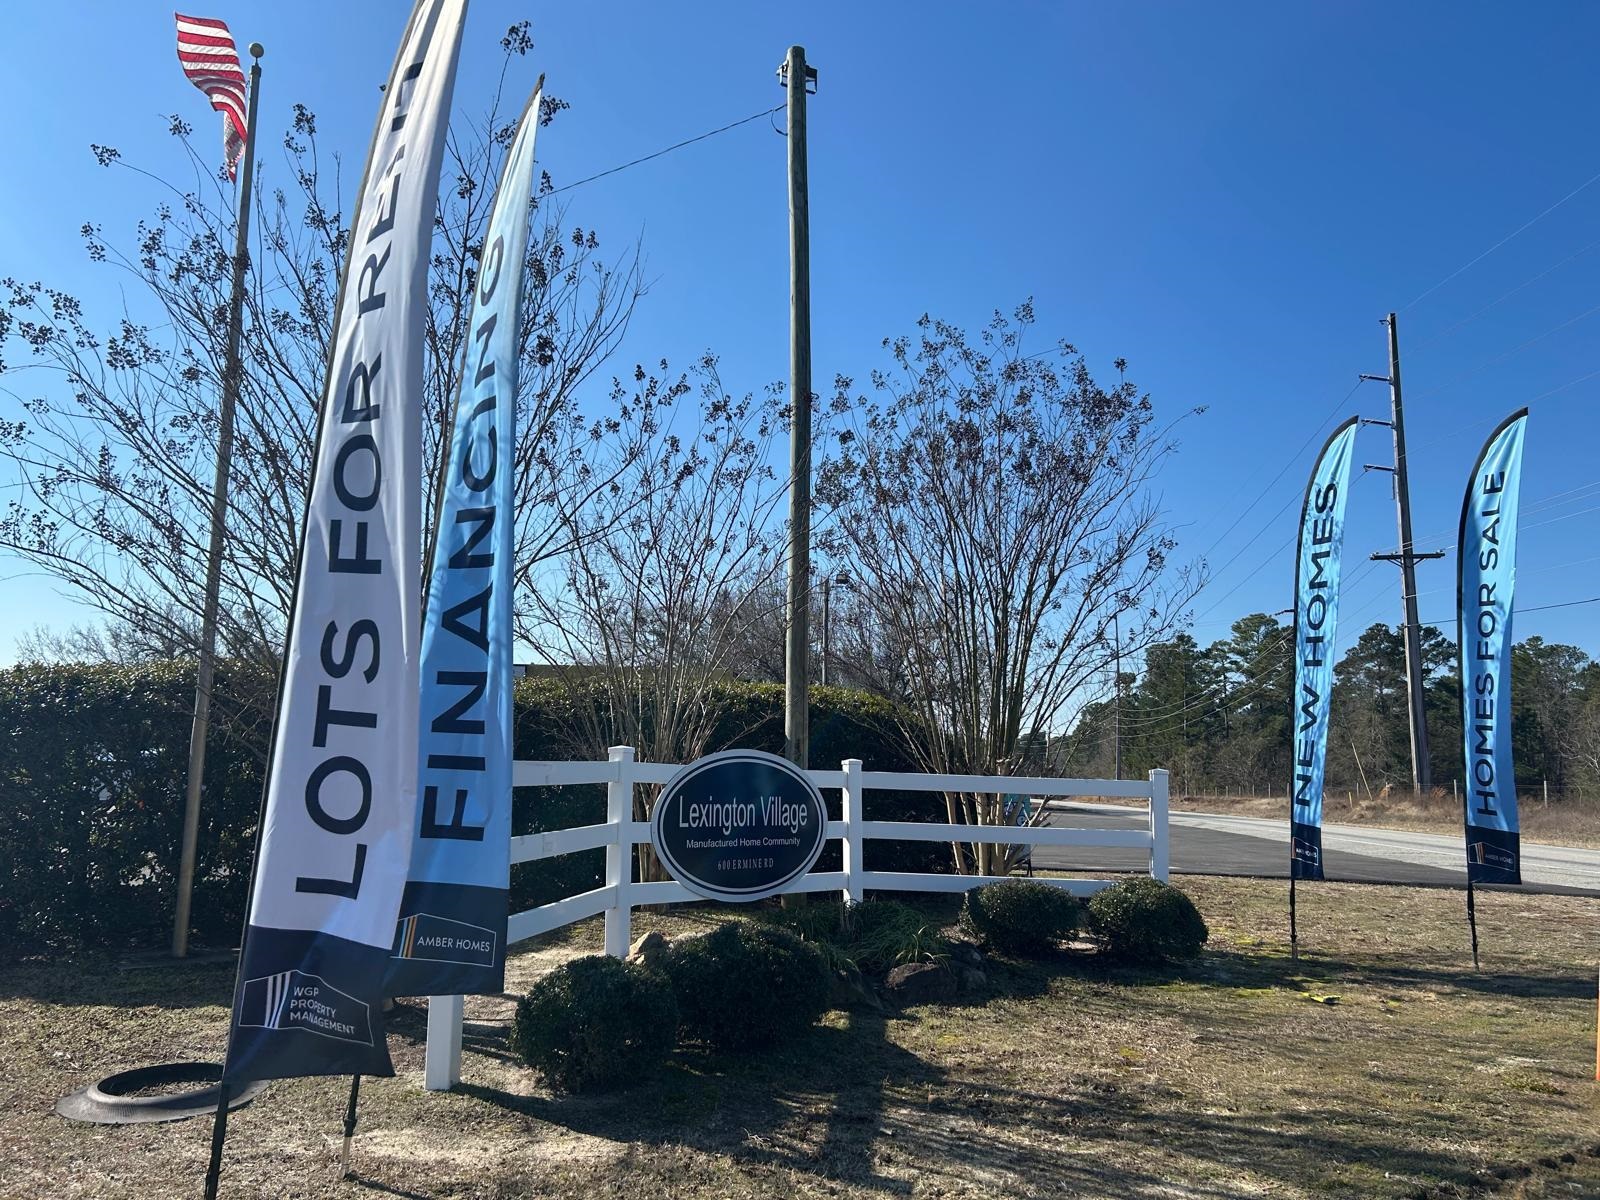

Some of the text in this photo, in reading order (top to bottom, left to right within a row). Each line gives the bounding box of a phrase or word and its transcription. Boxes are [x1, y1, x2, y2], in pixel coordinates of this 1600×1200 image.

[328, 352, 382, 575] FOR
[420, 234, 504, 842] FINANCING
[1295, 483, 1338, 807] NEW HOMES
[1474, 471, 1505, 817] HOMES FOR SALE
[295, 618, 382, 900] LOTS
[679, 796, 808, 835] Lexington Village
[686, 837, 801, 849] Manufactured Home Community
[718, 857, 774, 870] 600 ERMINE RD
[417, 937, 491, 952] AMBER HOMES
[293, 986, 319, 997] WGP
[290, 999, 337, 1018] PROPERTY
[290, 1010, 356, 1035] MANAGEMENT
